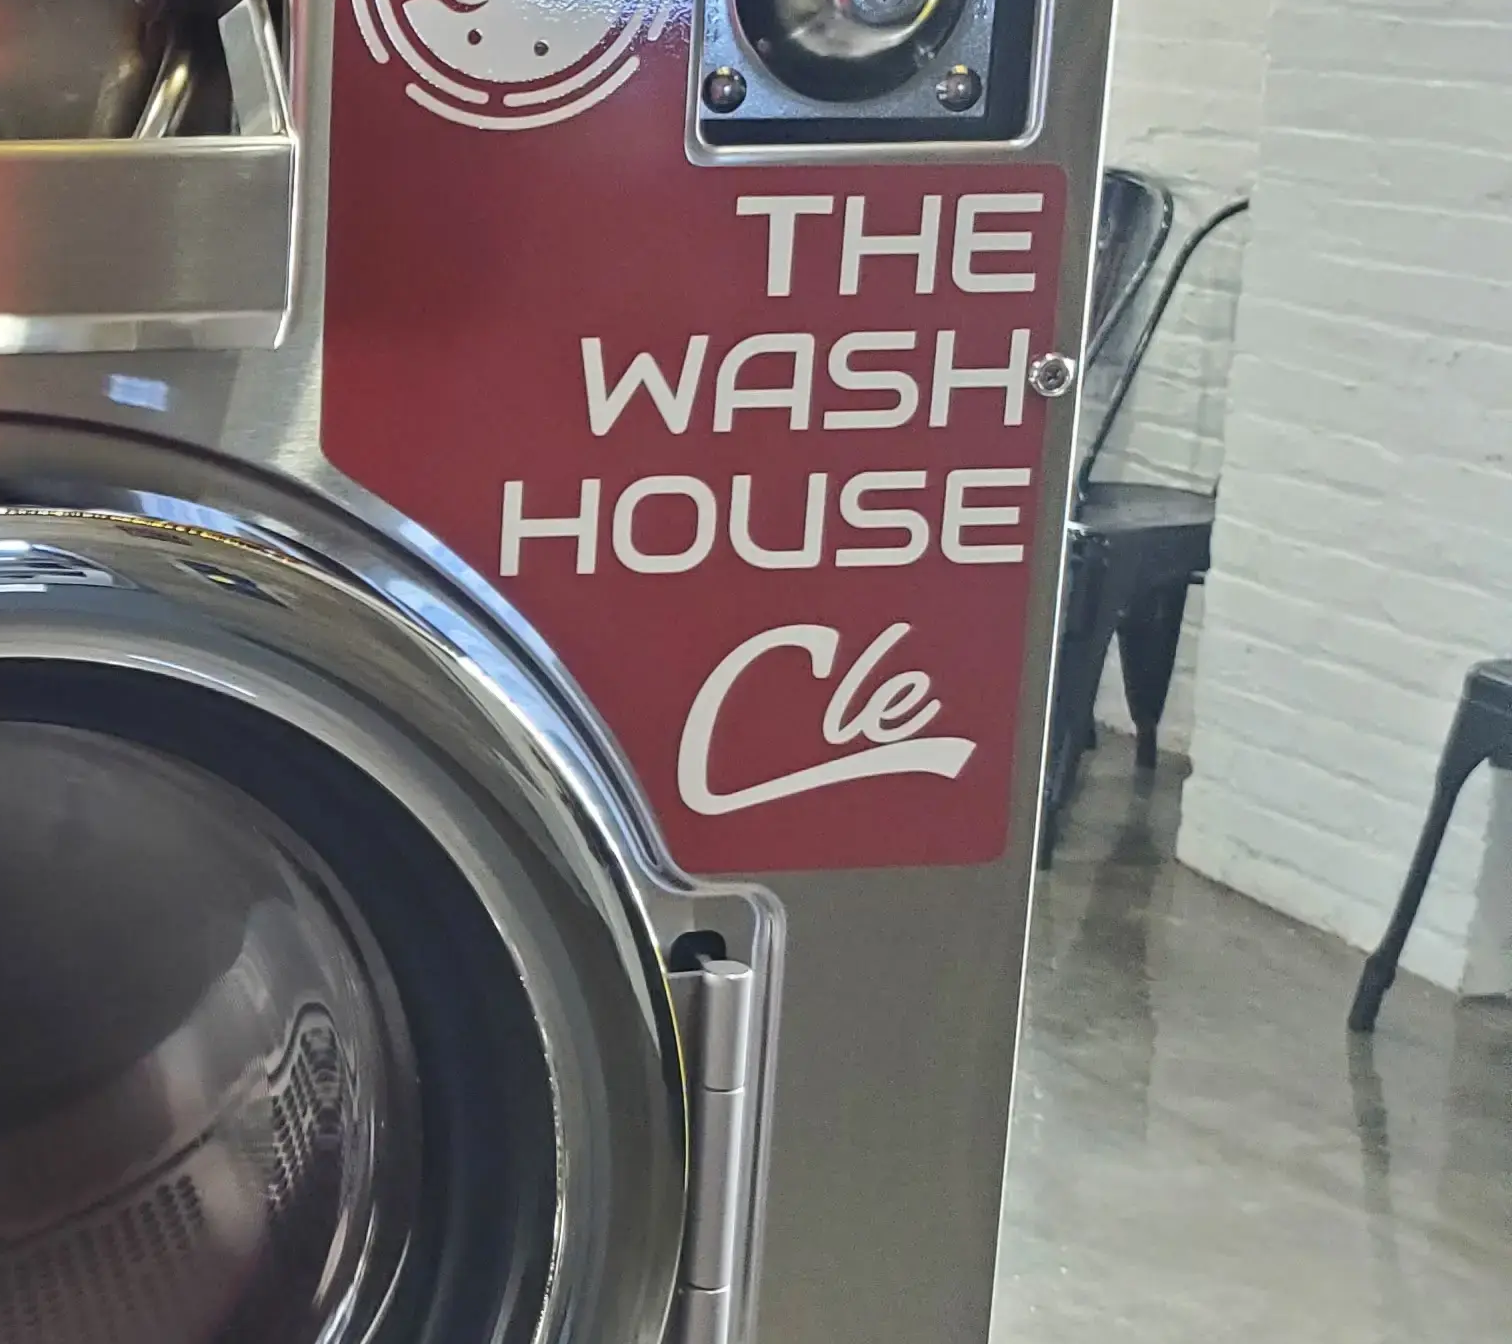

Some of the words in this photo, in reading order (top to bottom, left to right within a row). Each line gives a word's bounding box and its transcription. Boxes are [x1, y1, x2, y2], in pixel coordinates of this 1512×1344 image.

[736, 192, 1044, 297] THE
[580, 329, 1030, 436] WASH
[499, 467, 1032, 577] HOUSE
[677, 622, 977, 815] Cle
